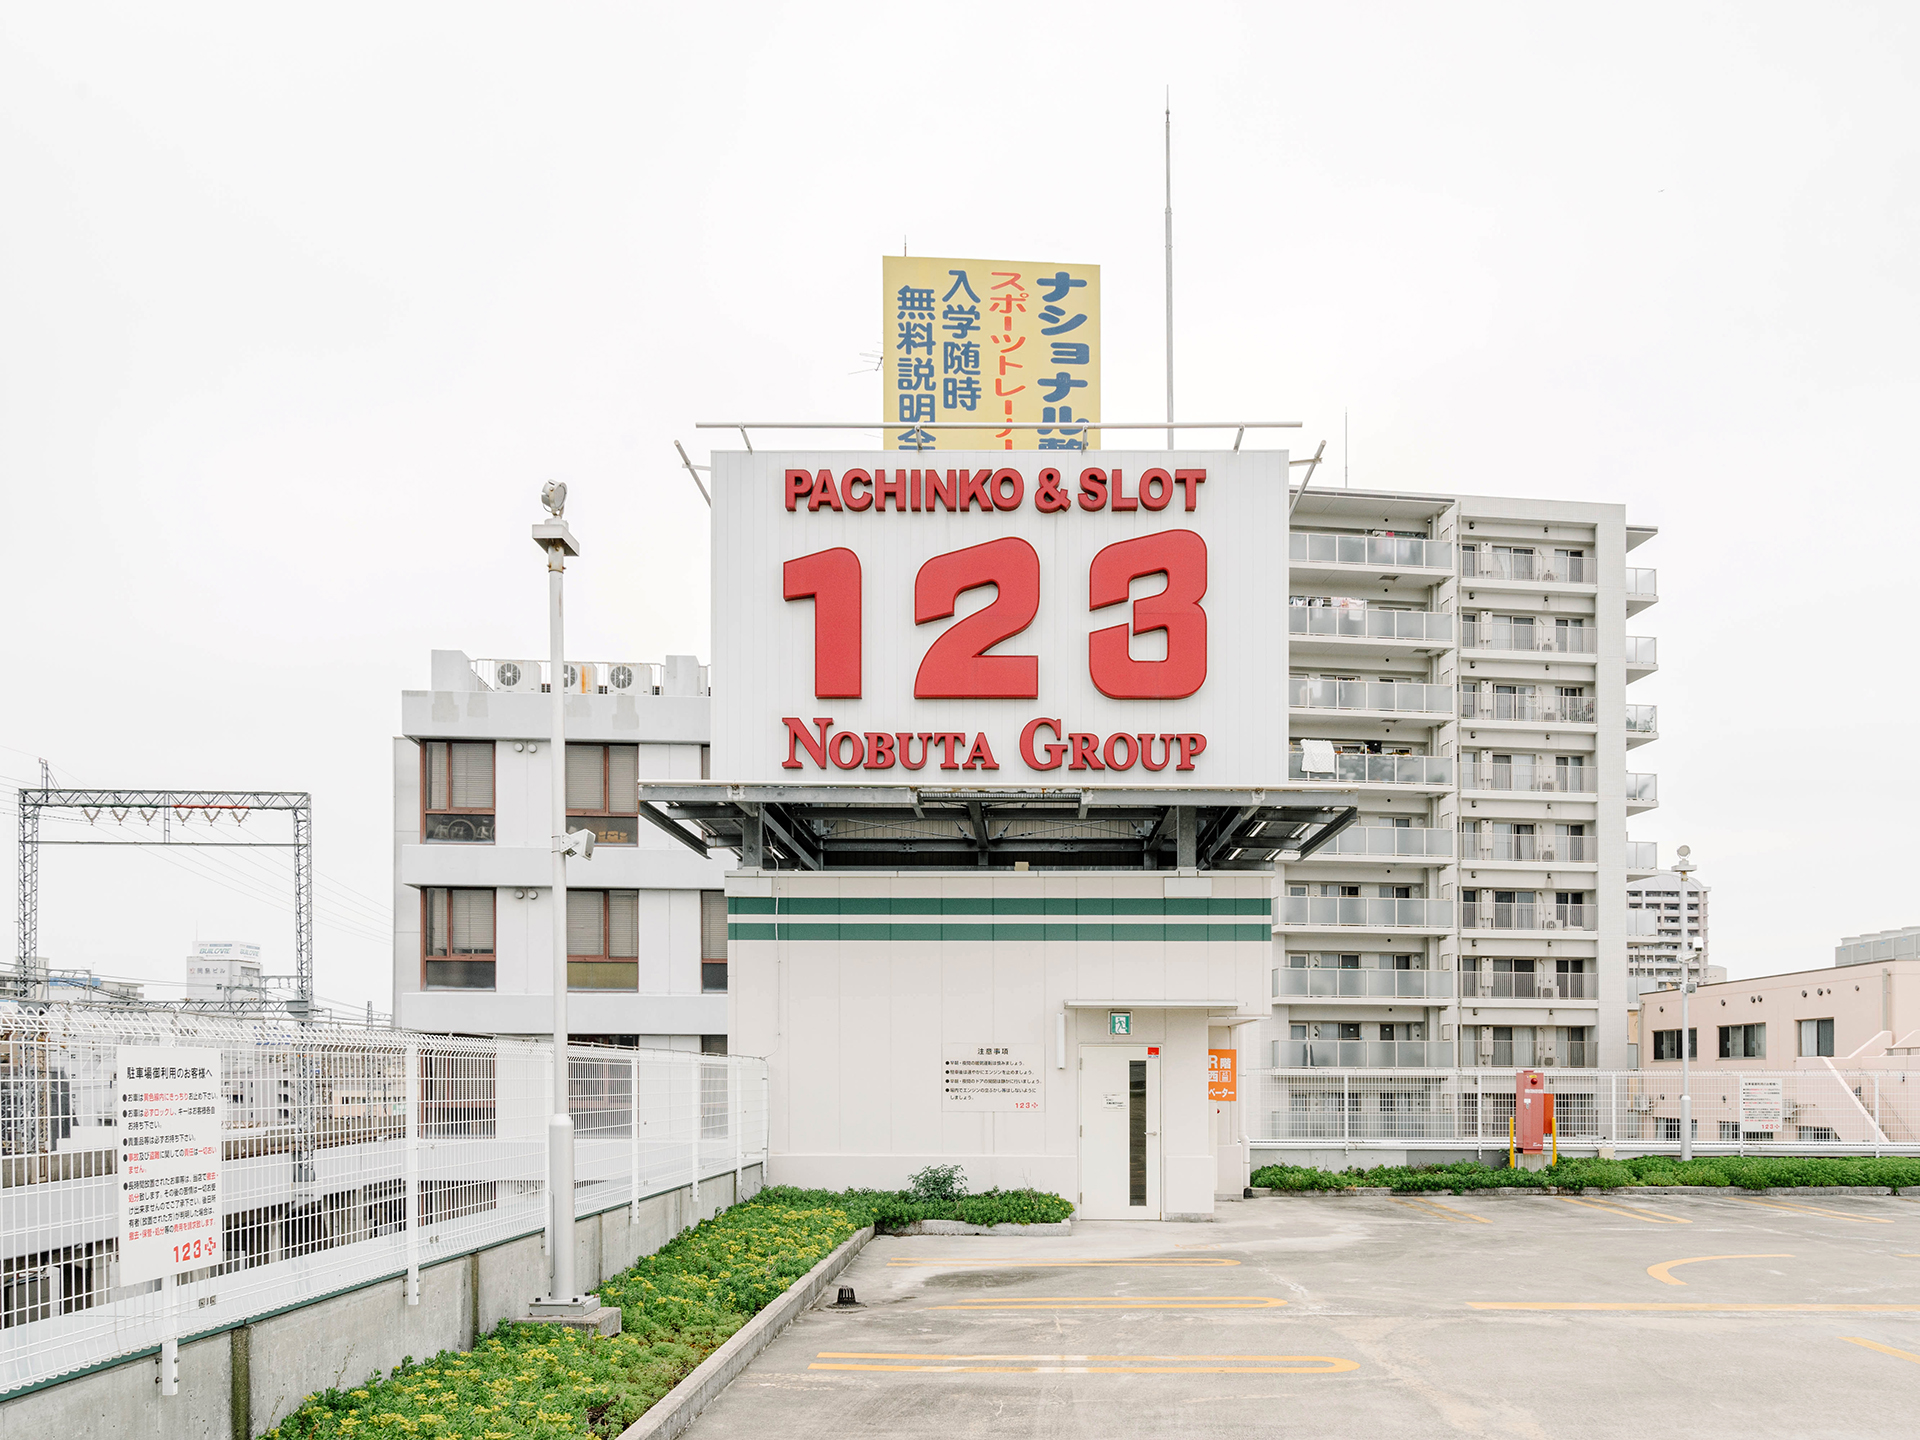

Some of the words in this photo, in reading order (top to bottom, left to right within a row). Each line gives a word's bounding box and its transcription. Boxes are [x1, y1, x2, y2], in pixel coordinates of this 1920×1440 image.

[942, 270, 982, 411] 入学随時
[785, 468, 1024, 512] PACHINKO
[1034, 467, 1072, 513] &
[1077, 467, 1207, 512] SLOT
[783, 529, 1208, 700] 123
[977, 1047, 1009, 1056] 注意事項
[126, 1066, 213, 1080] 駐車場御利用のお客様へ
[127, 1121, 162, 1131] お持ち下さい。
[128, 1165, 147, 1175] ません。
[172, 1239, 202, 1263] 123
